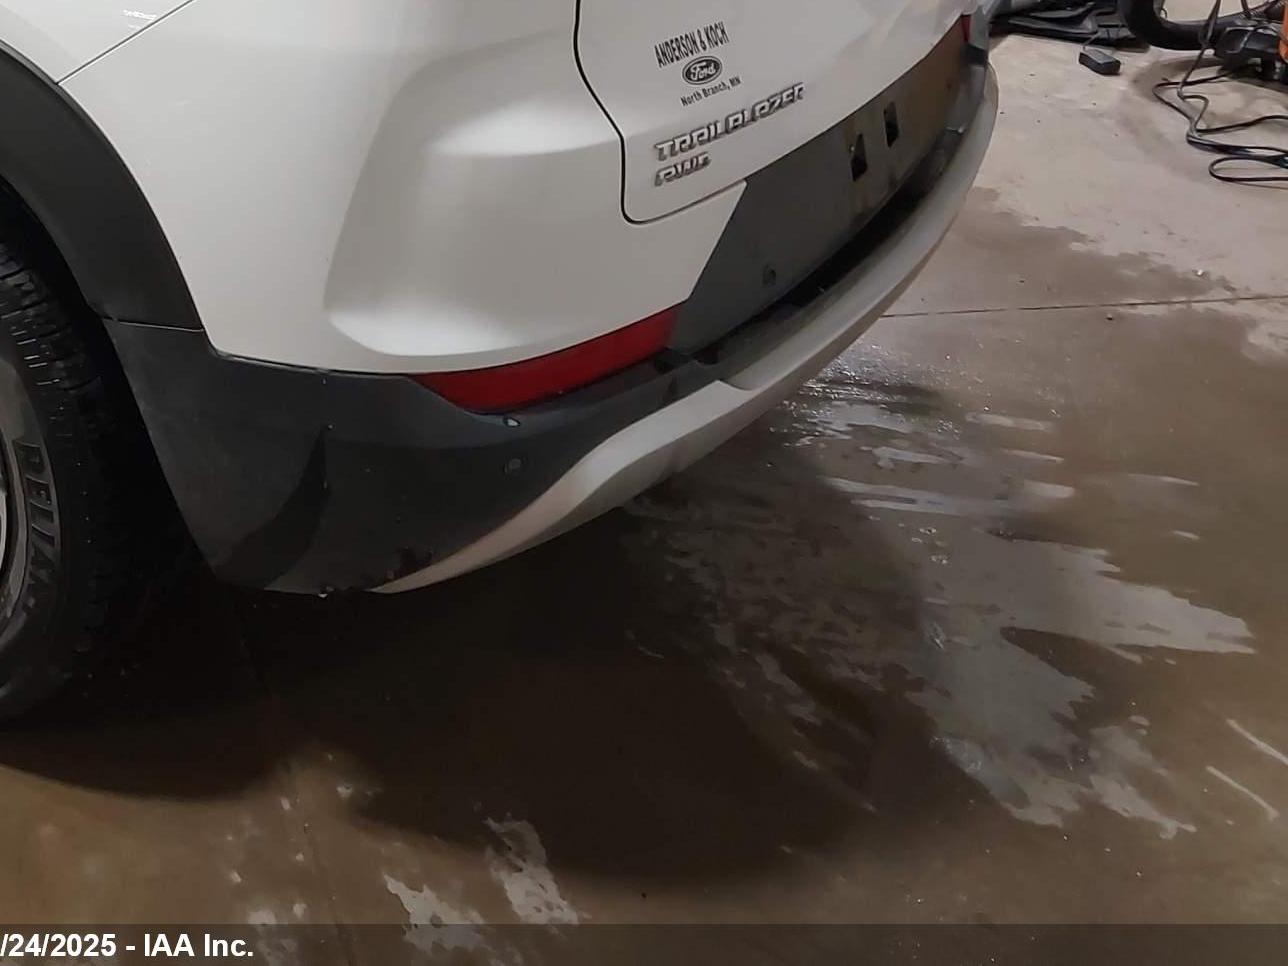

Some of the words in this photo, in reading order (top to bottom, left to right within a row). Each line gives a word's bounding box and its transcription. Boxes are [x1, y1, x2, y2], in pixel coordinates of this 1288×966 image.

[654, 31, 700, 68] ANDERSON
[697, 28, 708, 52] &
[704, 20, 730, 49] KOCH
[686, 59, 719, 82] Ford
[679, 90, 703, 107] North
